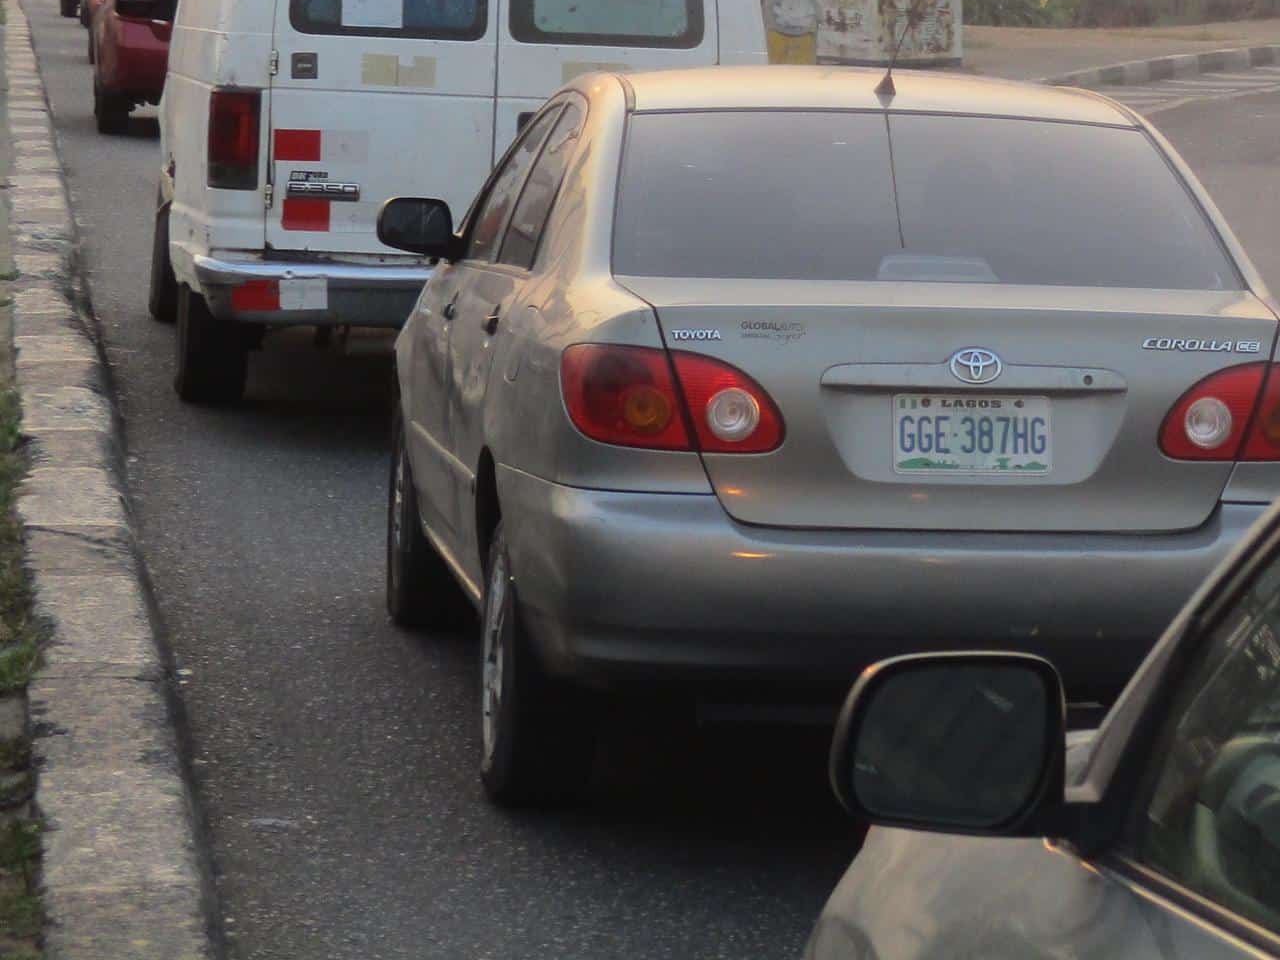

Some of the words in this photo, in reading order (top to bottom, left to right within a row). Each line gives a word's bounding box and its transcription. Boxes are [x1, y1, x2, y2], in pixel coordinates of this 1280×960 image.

[671, 329, 722, 341] TOYOTA
[1142, 338, 1232, 352] COROLLA
[941, 399, 1002, 408] LAGOS
